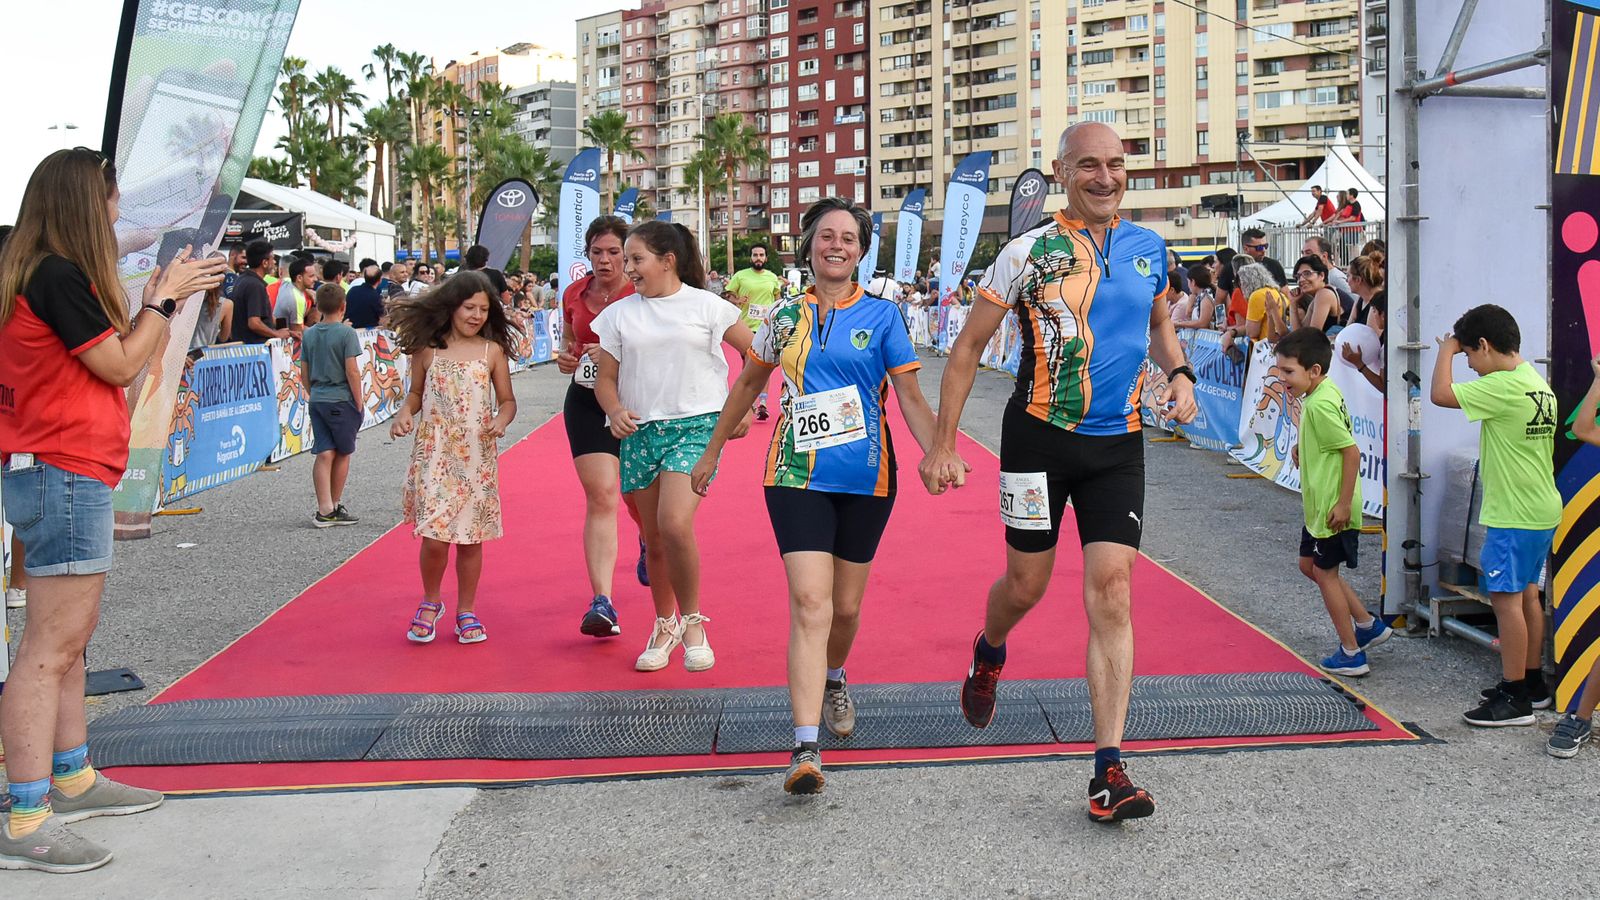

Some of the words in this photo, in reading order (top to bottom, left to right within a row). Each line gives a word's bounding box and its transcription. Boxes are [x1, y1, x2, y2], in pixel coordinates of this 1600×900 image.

[904, 219, 913, 267] Sergeyco
[956, 193, 970, 259] Sergeyco
[197, 364, 228, 410] CARRERA
[228, 360, 271, 403] POPULAR
[1195, 382, 1237, 401] ALGECIRAS
[797, 412, 831, 437] 266
[1359, 444, 1385, 481] cir
